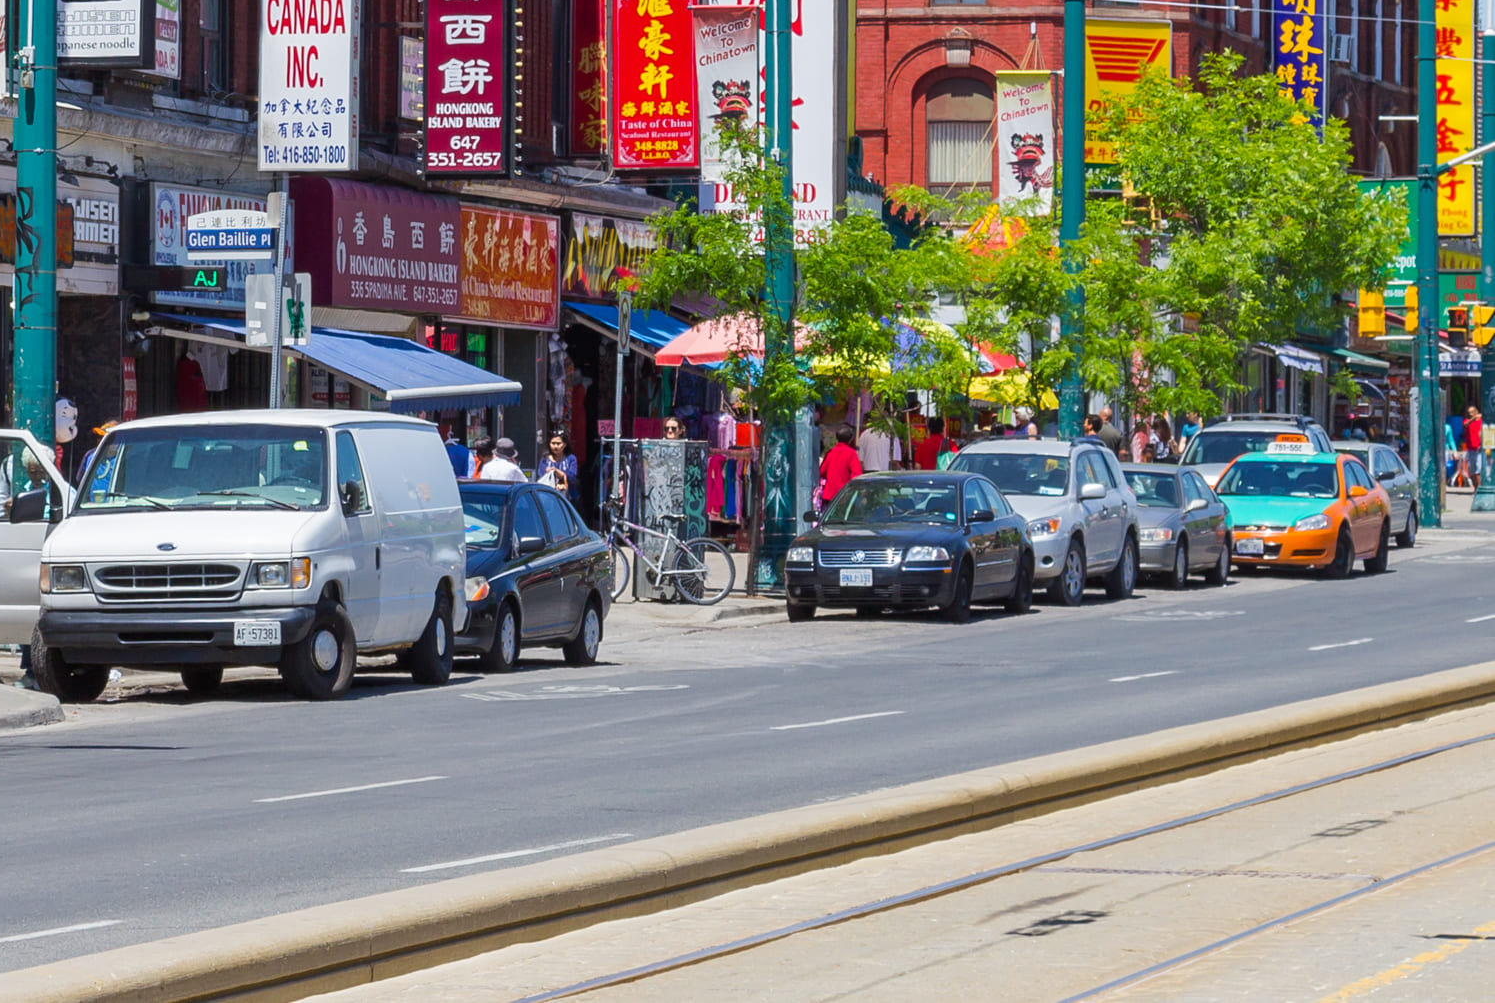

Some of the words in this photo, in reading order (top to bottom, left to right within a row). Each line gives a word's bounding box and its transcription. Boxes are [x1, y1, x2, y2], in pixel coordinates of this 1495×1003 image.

[700, 16, 752, 40] Welcome
[99, 36, 136, 51] noodle
[720, 36, 734, 48] To
[698, 42, 757, 68] Chinatown
[286, 45, 325, 89] INC.
[1002, 81, 1046, 99] Welcome
[263, 98, 347, 117] 加拿大紀念品
[436, 101, 494, 116] HONGKONG
[1018, 97, 1031, 108] To
[1000, 103, 1049, 123] Chinatown
[277, 121, 333, 140] 有限公司
[427, 116, 464, 129] ISLAND
[466, 116, 502, 130] BAKERY
[620, 119, 647, 130] Taste
[649, 118, 661, 129] of
[662, 118, 693, 129] China
[450, 135, 480, 151] 647
[634, 140, 679, 152] 348-8828
[263, 145, 281, 164] Tel:
[282, 144, 346, 166] 416-850-1800
[427, 151, 502, 168] 351-2657
[189, 232, 216, 247] Glen
[218, 231, 257, 247] Baillie
[261, 233, 271, 246] Pl
[352, 211, 456, 256] 香島西餅
[349, 255, 396, 283] HONGKONG
[397, 258, 427, 283] ISLAND
[427, 260, 458, 285] BAKERY
[1387, 254, 1417, 272] epot
[193, 270, 218, 287] AJ
[365, 282, 392, 300] SPADINA
[412, 285, 458, 307] 647-351-2657
[469, 277, 489, 297] China
[489, 278, 515, 300] Seafood
[515, 282, 553, 304] Restaurant
[251, 627, 278, 641] 57381
